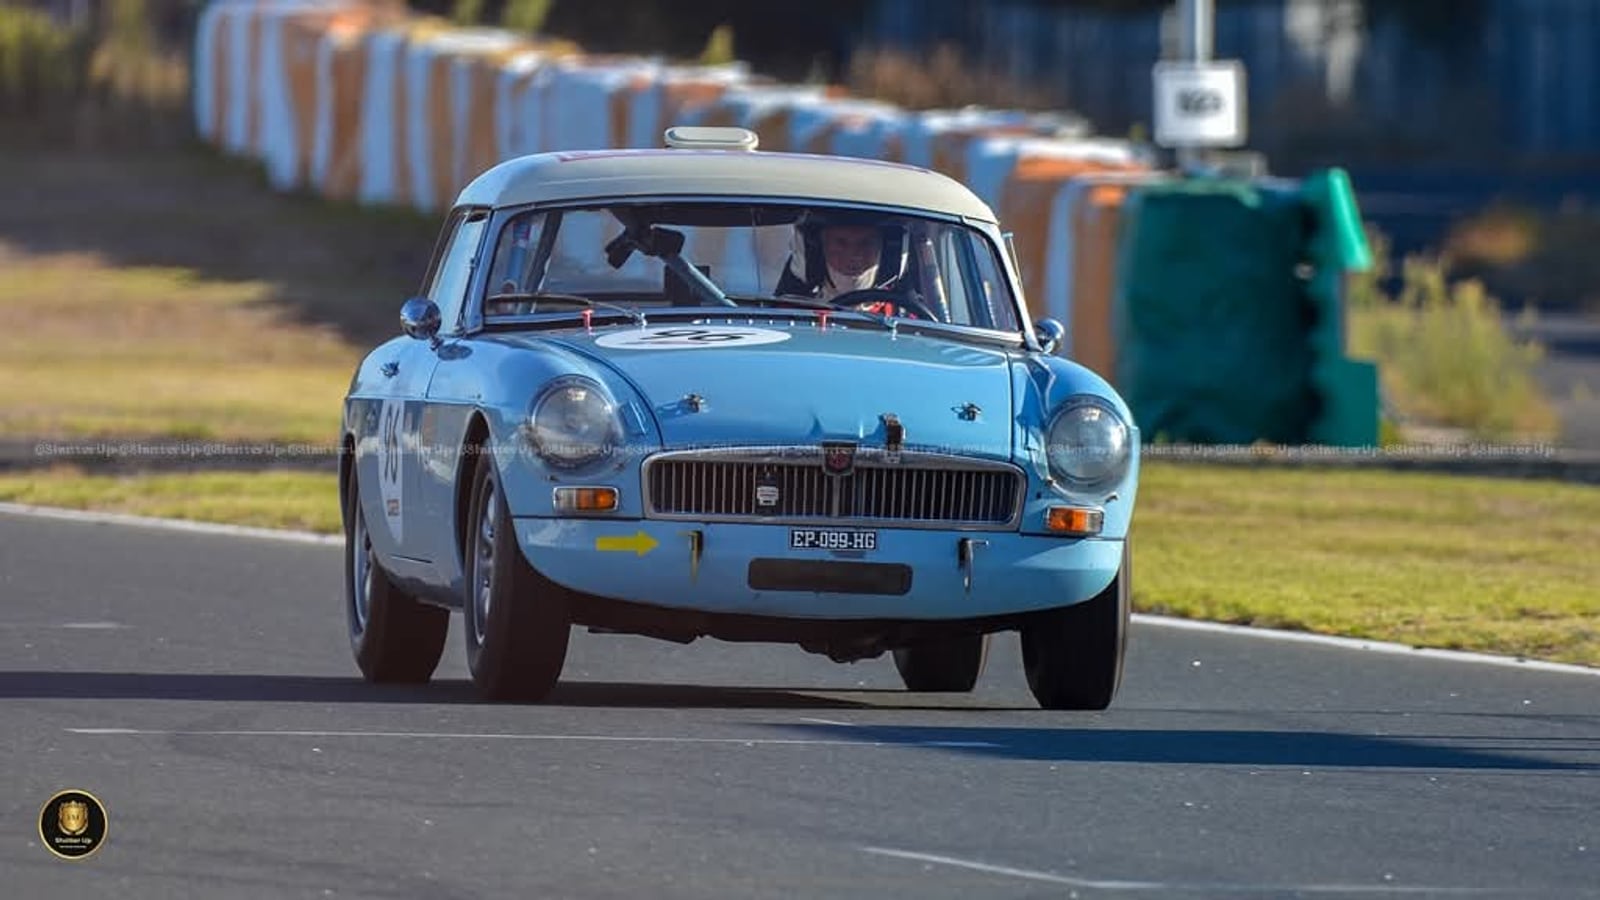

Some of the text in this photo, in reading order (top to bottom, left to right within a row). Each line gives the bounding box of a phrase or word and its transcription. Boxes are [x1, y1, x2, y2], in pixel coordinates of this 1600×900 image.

[640, 329, 756, 343] 96
[384, 404, 400, 485] 96
[793, 531, 875, 549] EP-099-HG
